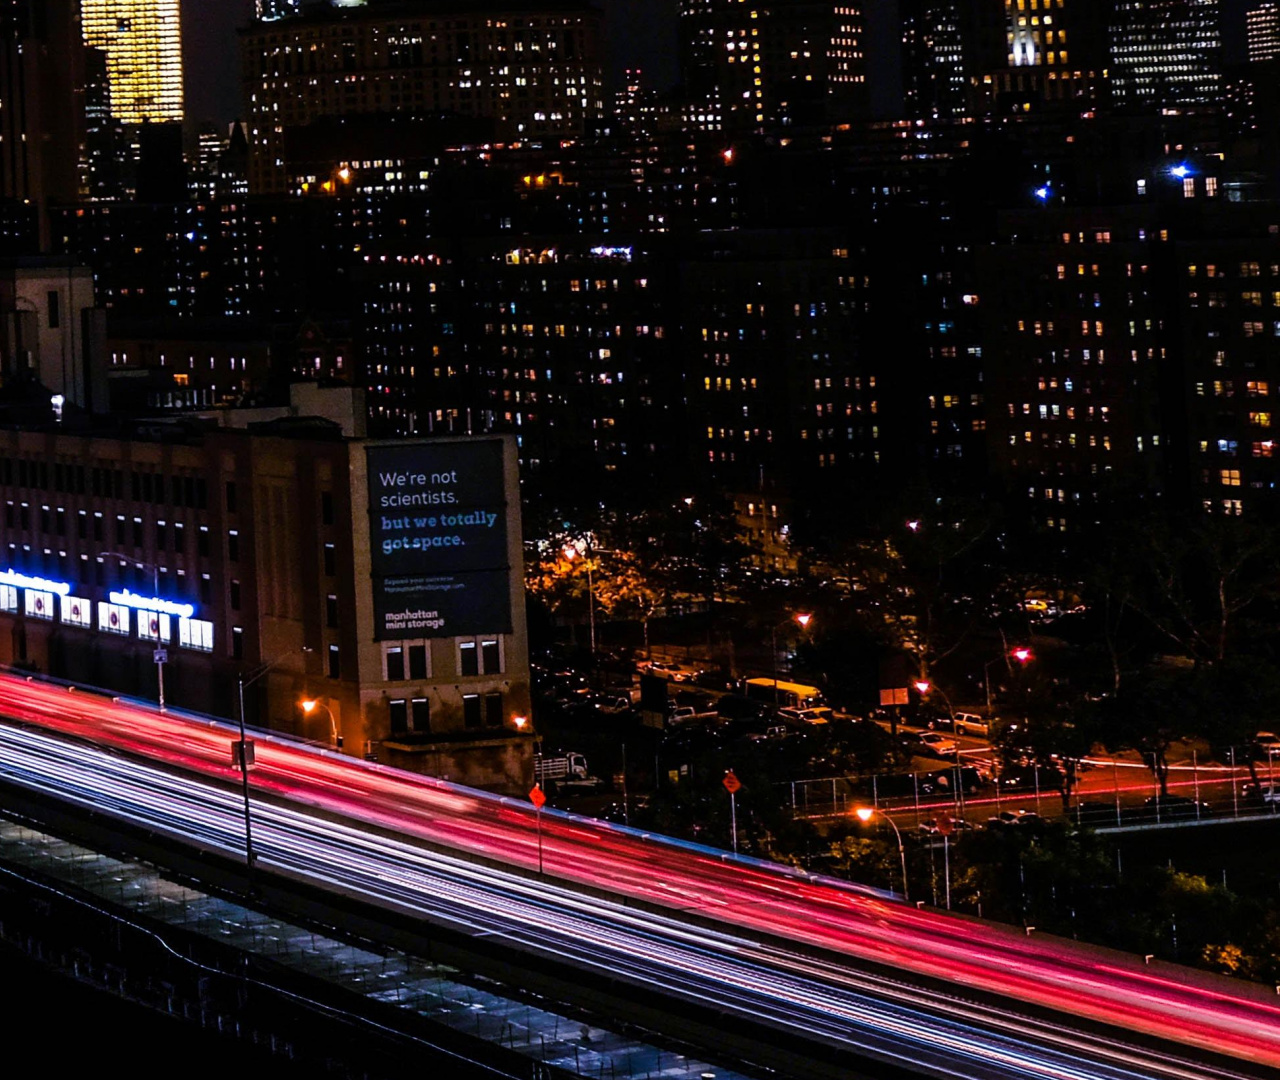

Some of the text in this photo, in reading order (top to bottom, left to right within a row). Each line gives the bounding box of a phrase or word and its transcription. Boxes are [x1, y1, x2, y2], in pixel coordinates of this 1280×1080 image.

[380, 470, 457, 487] We're not
[380, 491, 459, 507] scientists,
[381, 510, 498, 530] but we totally
[382, 535, 466, 555] got space.
[385, 608, 438, 621] manhattan
[385, 619, 445, 630] mini storage
